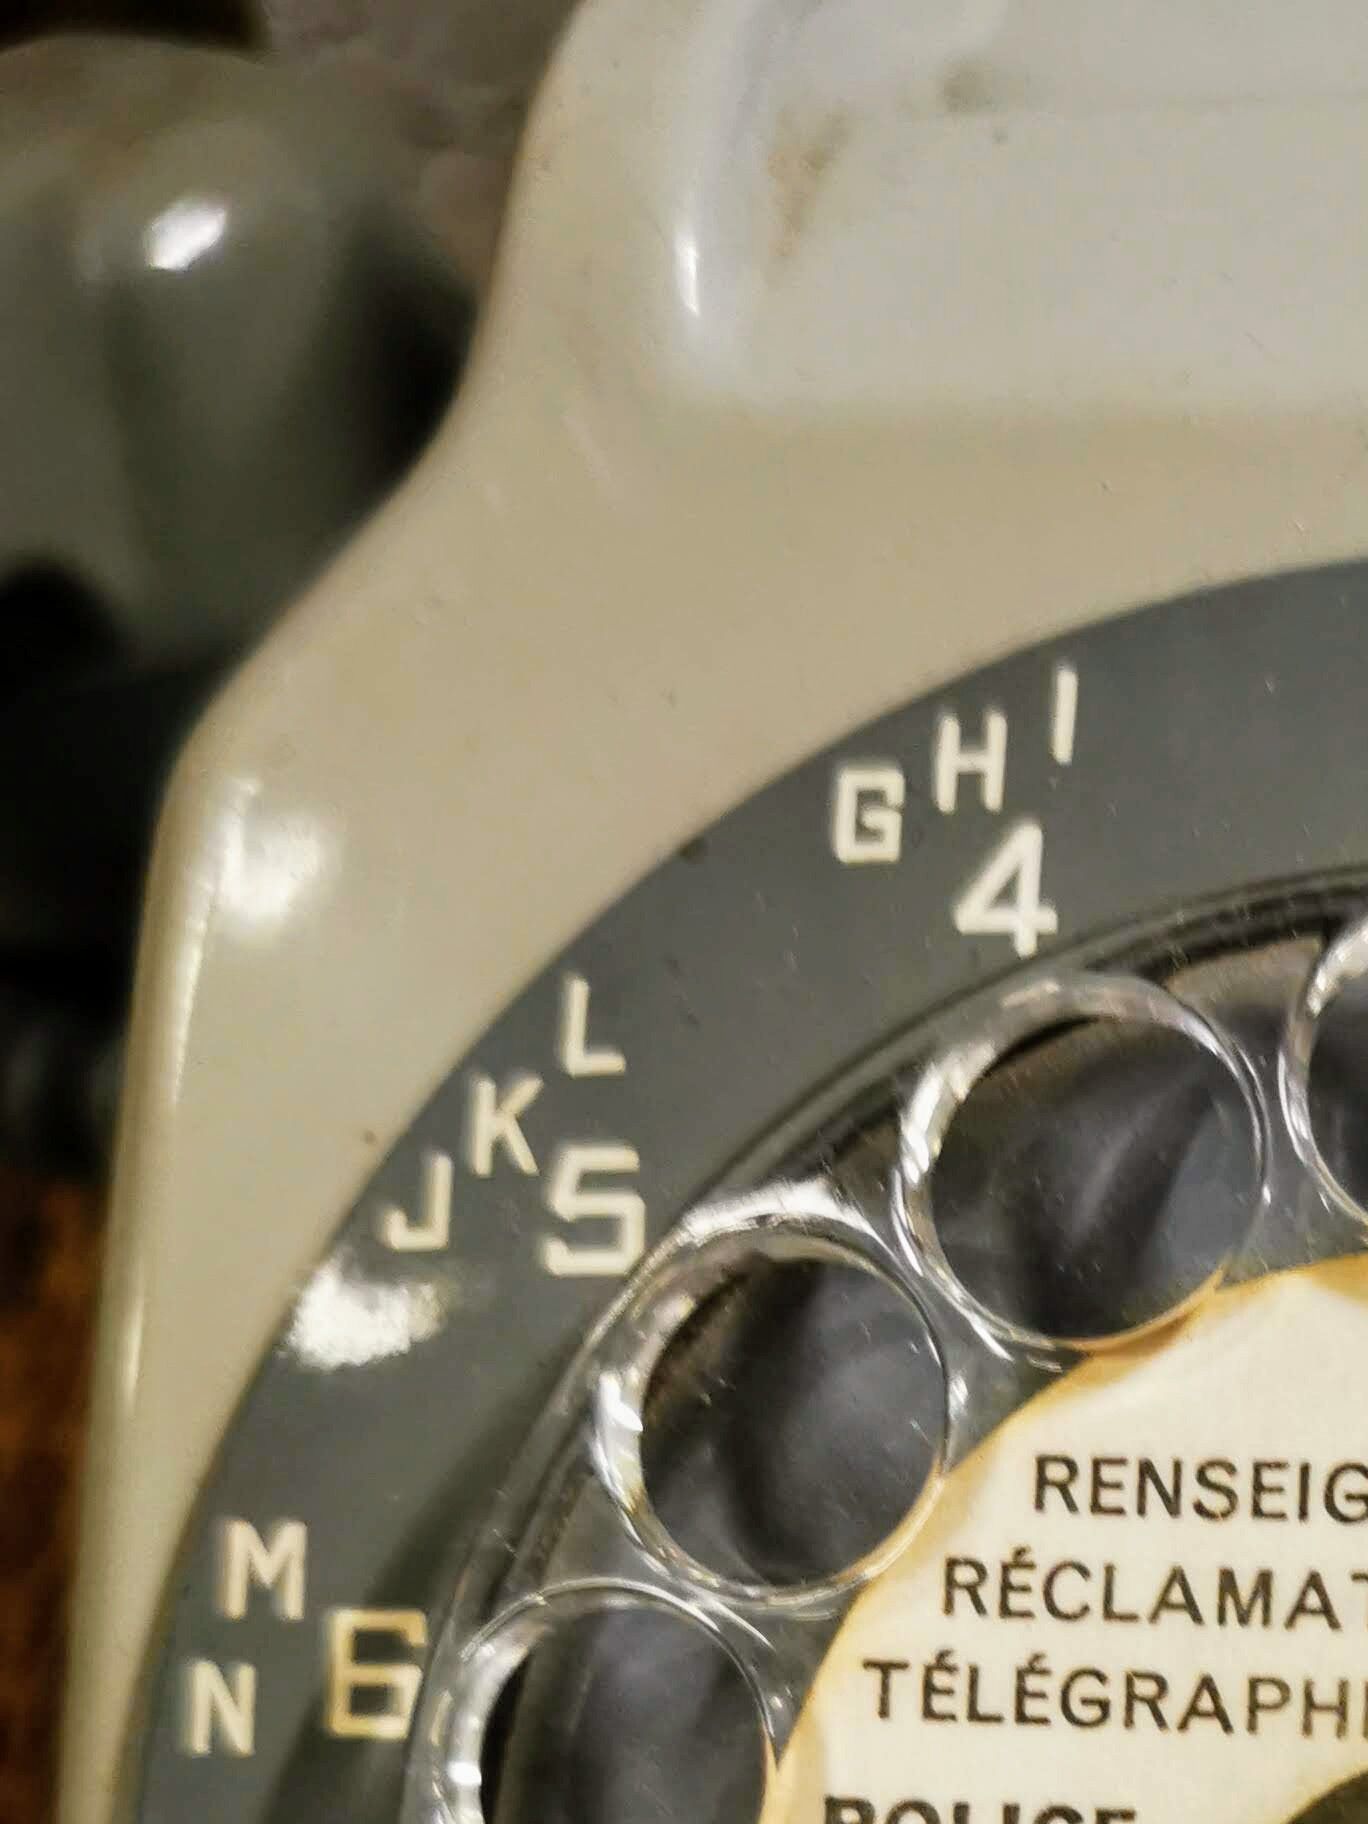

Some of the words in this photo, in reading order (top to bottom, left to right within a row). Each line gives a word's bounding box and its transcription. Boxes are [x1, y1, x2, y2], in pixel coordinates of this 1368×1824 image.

[953, 818, 1058, 957] 4
[539, 1142, 648, 1277] 5
[325, 1607, 428, 1741] 6
